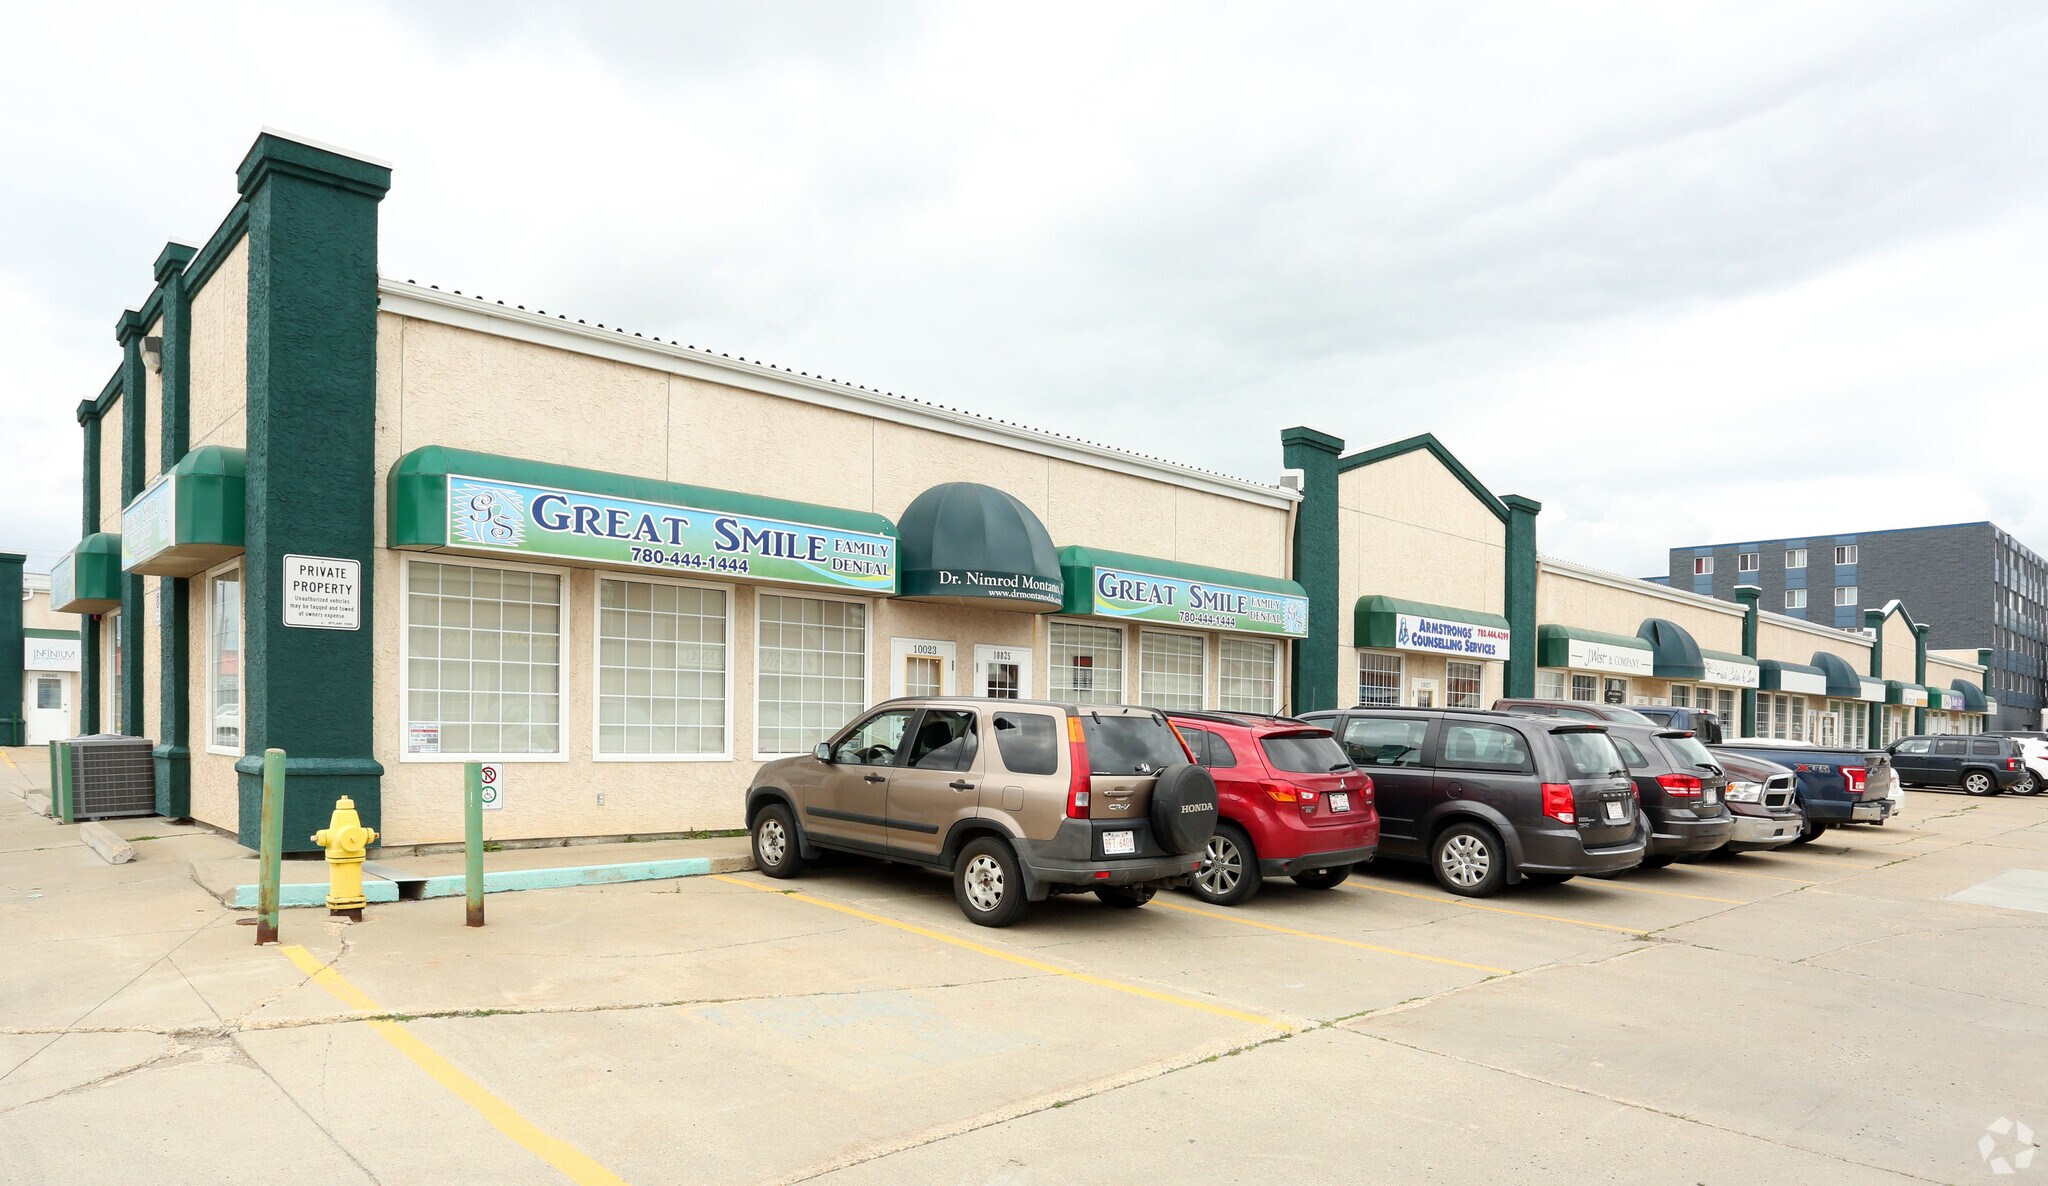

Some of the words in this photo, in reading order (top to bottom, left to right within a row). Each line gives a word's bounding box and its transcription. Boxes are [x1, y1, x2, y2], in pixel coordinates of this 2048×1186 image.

[531, 493, 690, 547] GREAT
[714, 517, 828, 563] SMILE
[834, 539, 889, 558] FAMILY
[631, 547, 749, 573] 780-444-1444
[832, 557, 891, 576] DENTAL
[300, 564, 347, 579] PRIVATE
[939, 570, 962, 584] Dr.
[966, 571, 1019, 588] Nimrod
[293, 580, 353, 595] PROPERTY
[1098, 572, 1177, 607] GREAT
[1189, 584, 1248, 615] SMILE
[294, 595, 329, 603] Unauthorized
[1250, 597, 1281, 610] FAMILY
[1179, 611, 1237, 628] 780-444-1444
[1249, 611, 1282, 624] DENTAL
[1418, 618, 1474, 640] ARMSTRONGS'
[913, 644, 937, 655] 10023
[1411, 631, 1463, 652] COUNSELLING
[1464, 638, 1496, 656] SERVICES
[33, 649, 75, 660] INFINIUM
[993, 651, 1011, 660] 10025
[1608, 656, 1613, 665] &
[1614, 655, 1639, 668] COMPANY
[1108, 803, 1131, 811] CR-V
[1181, 802, 1214, 814] HONDA
